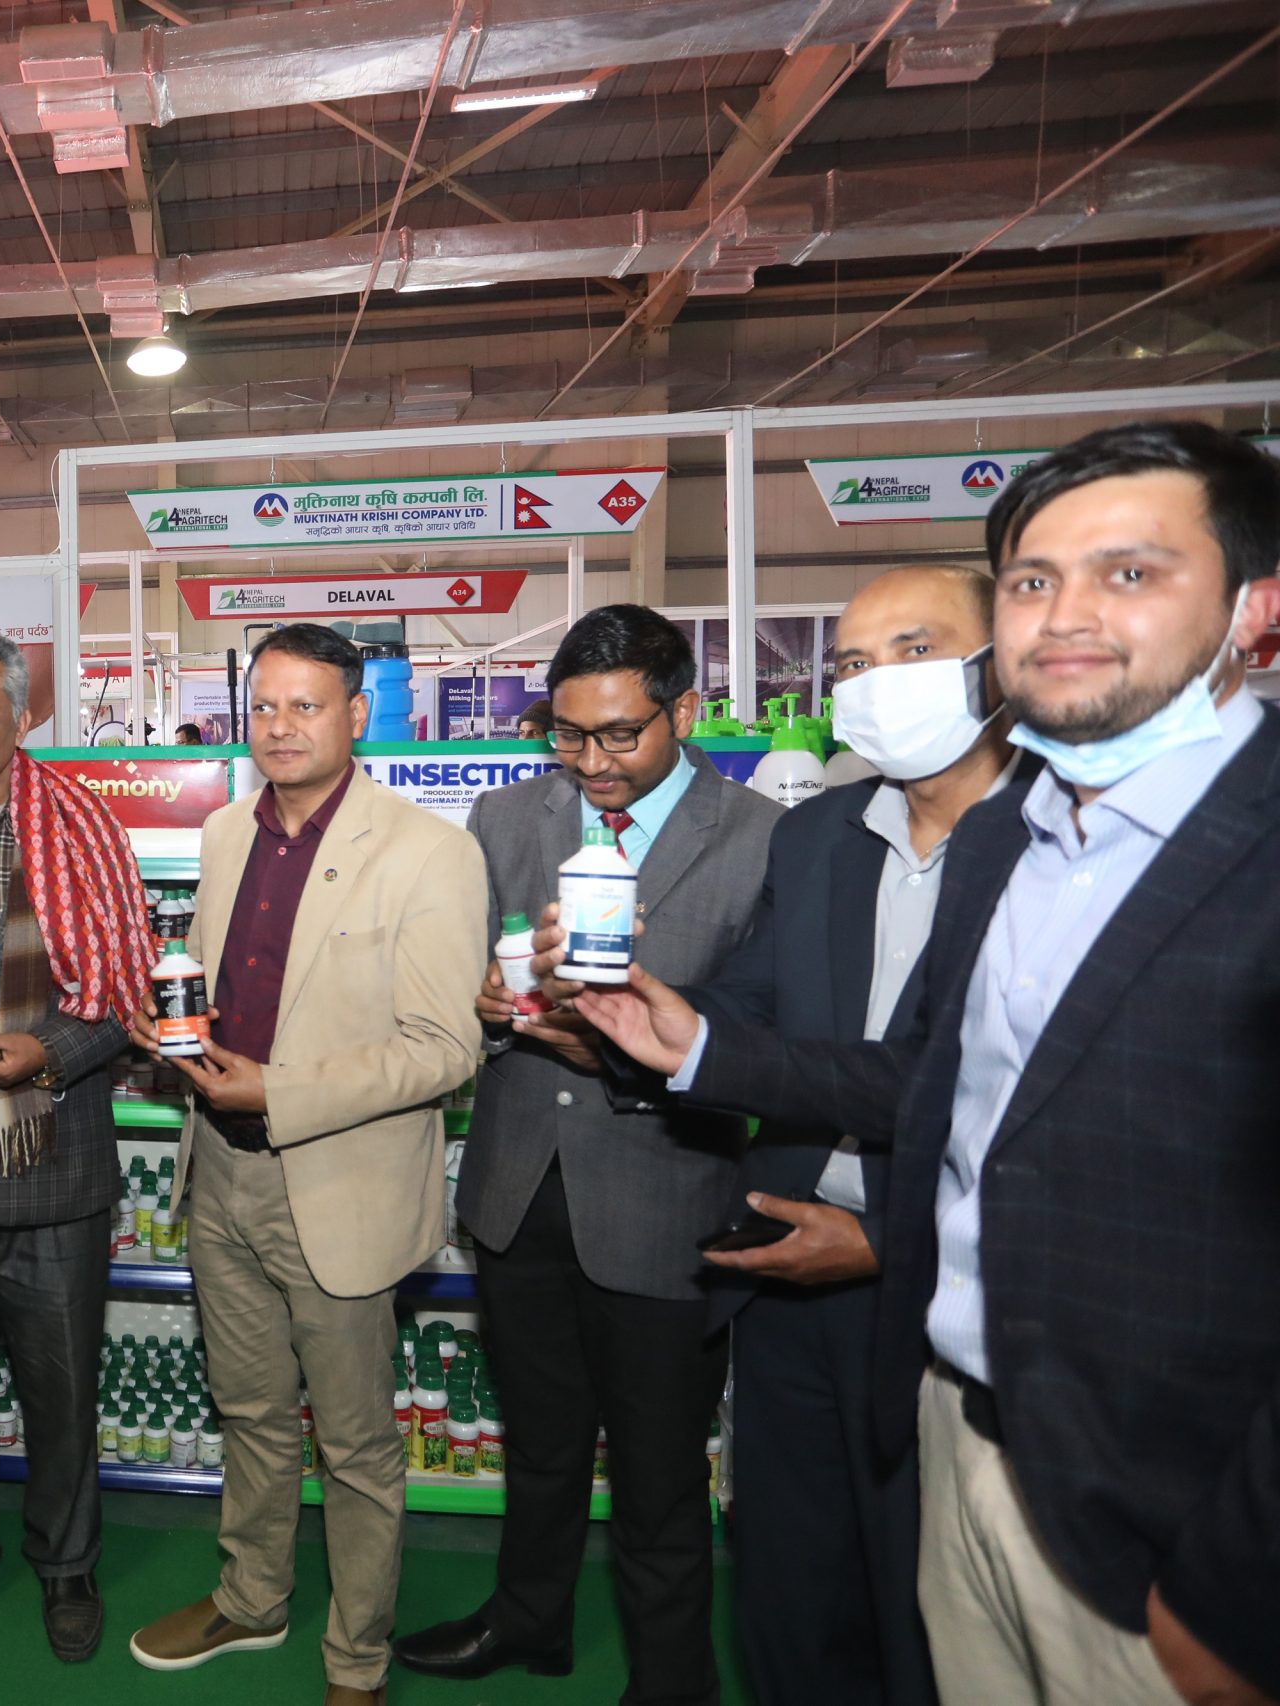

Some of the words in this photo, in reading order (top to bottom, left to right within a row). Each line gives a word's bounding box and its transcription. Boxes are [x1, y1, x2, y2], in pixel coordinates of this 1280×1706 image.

[875, 477, 899, 485] NEPAL
[875, 485, 930, 496] AGRITECH
[293, 492, 361, 512] मुक्तिनाथ
[365, 489, 398, 509] कृषि
[403, 487, 459, 504] कम्पनी
[463, 486, 488, 502] लि.
[608, 496, 637, 507] A35
[182, 514, 228, 525] AGRITECH
[294, 512, 358, 524] MUKTINATH
[361, 511, 399, 522] KRISHI
[401, 509, 462, 521] COMPANY
[465, 508, 488, 518] LTD.
[345, 524, 369, 534] आधार
[426, 522, 450, 532] आधार
[327, 590, 395, 603] DELAVAL
[452, 589, 467, 597] A34
[247, 595, 285, 604] AGRITECH
[84, 779, 184, 803] emony
